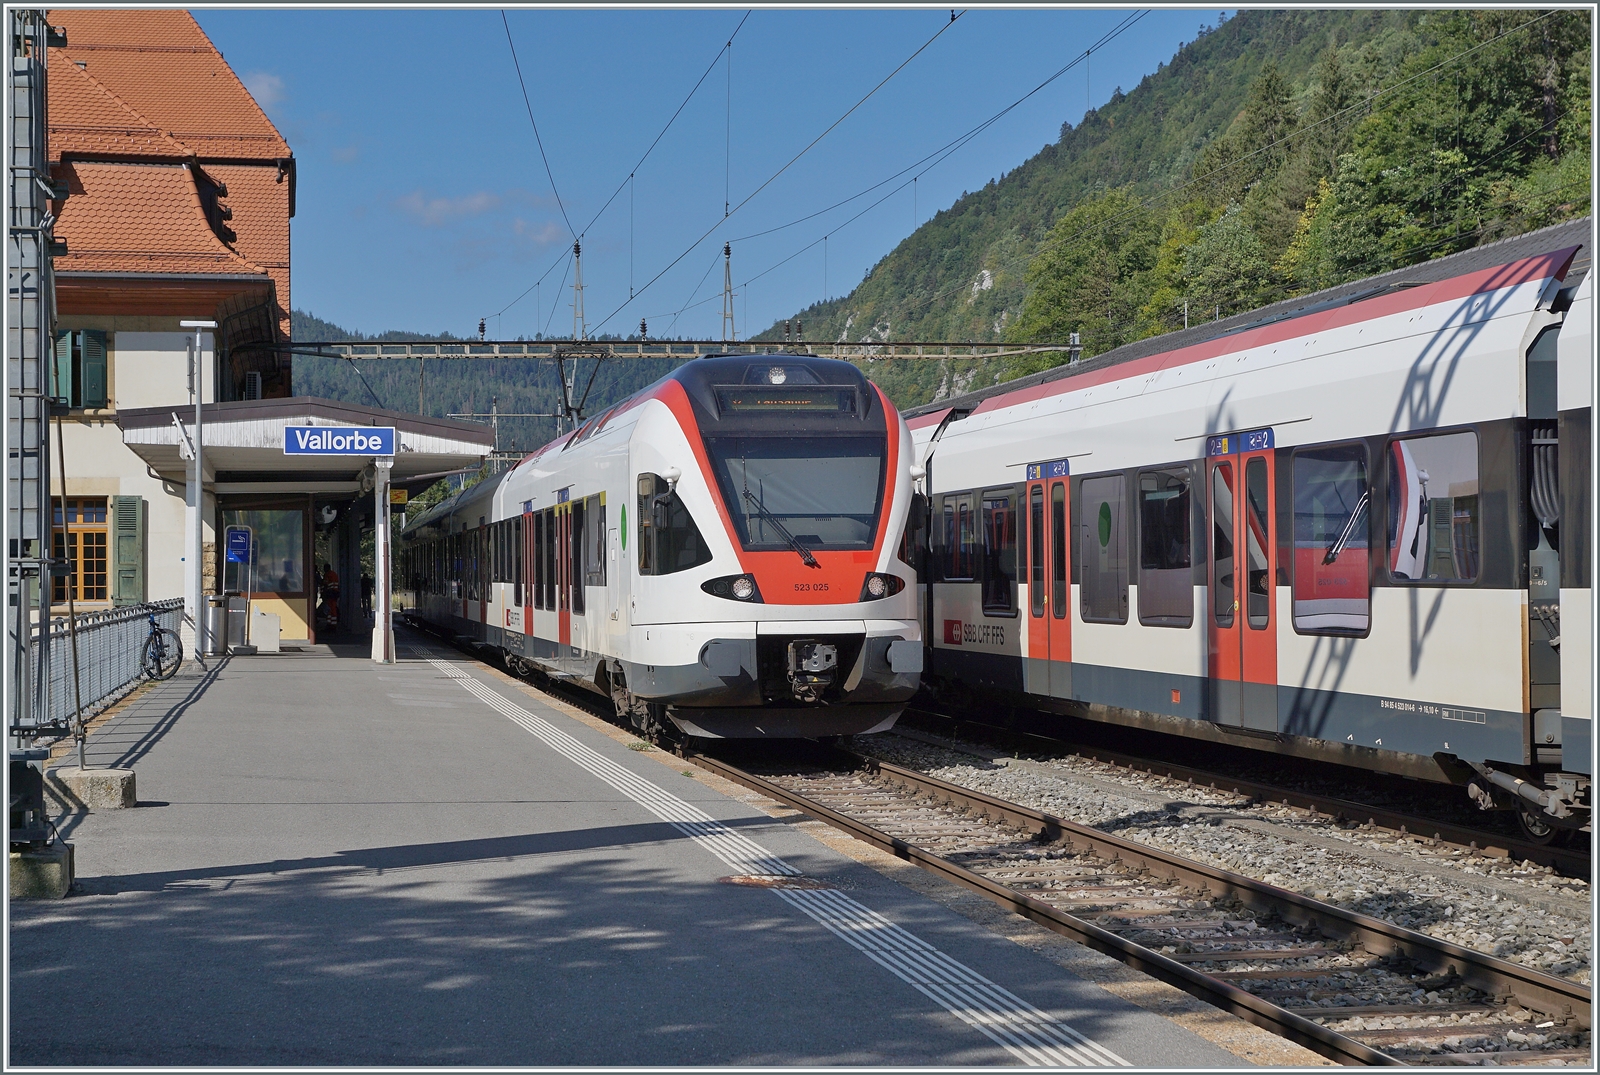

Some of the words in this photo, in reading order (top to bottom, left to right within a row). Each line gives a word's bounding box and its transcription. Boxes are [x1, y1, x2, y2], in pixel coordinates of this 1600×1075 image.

[295, 430, 382, 450] Vallorbe
[1210, 440, 1216, 455] 2
[1262, 431, 1268, 448] 2
[794, 583, 810, 592] 523
[812, 583, 829, 592] 025
[964, 624, 976, 642] SBB
[978, 624, 990, 644] CFF
[992, 626, 1004, 645] FFS
